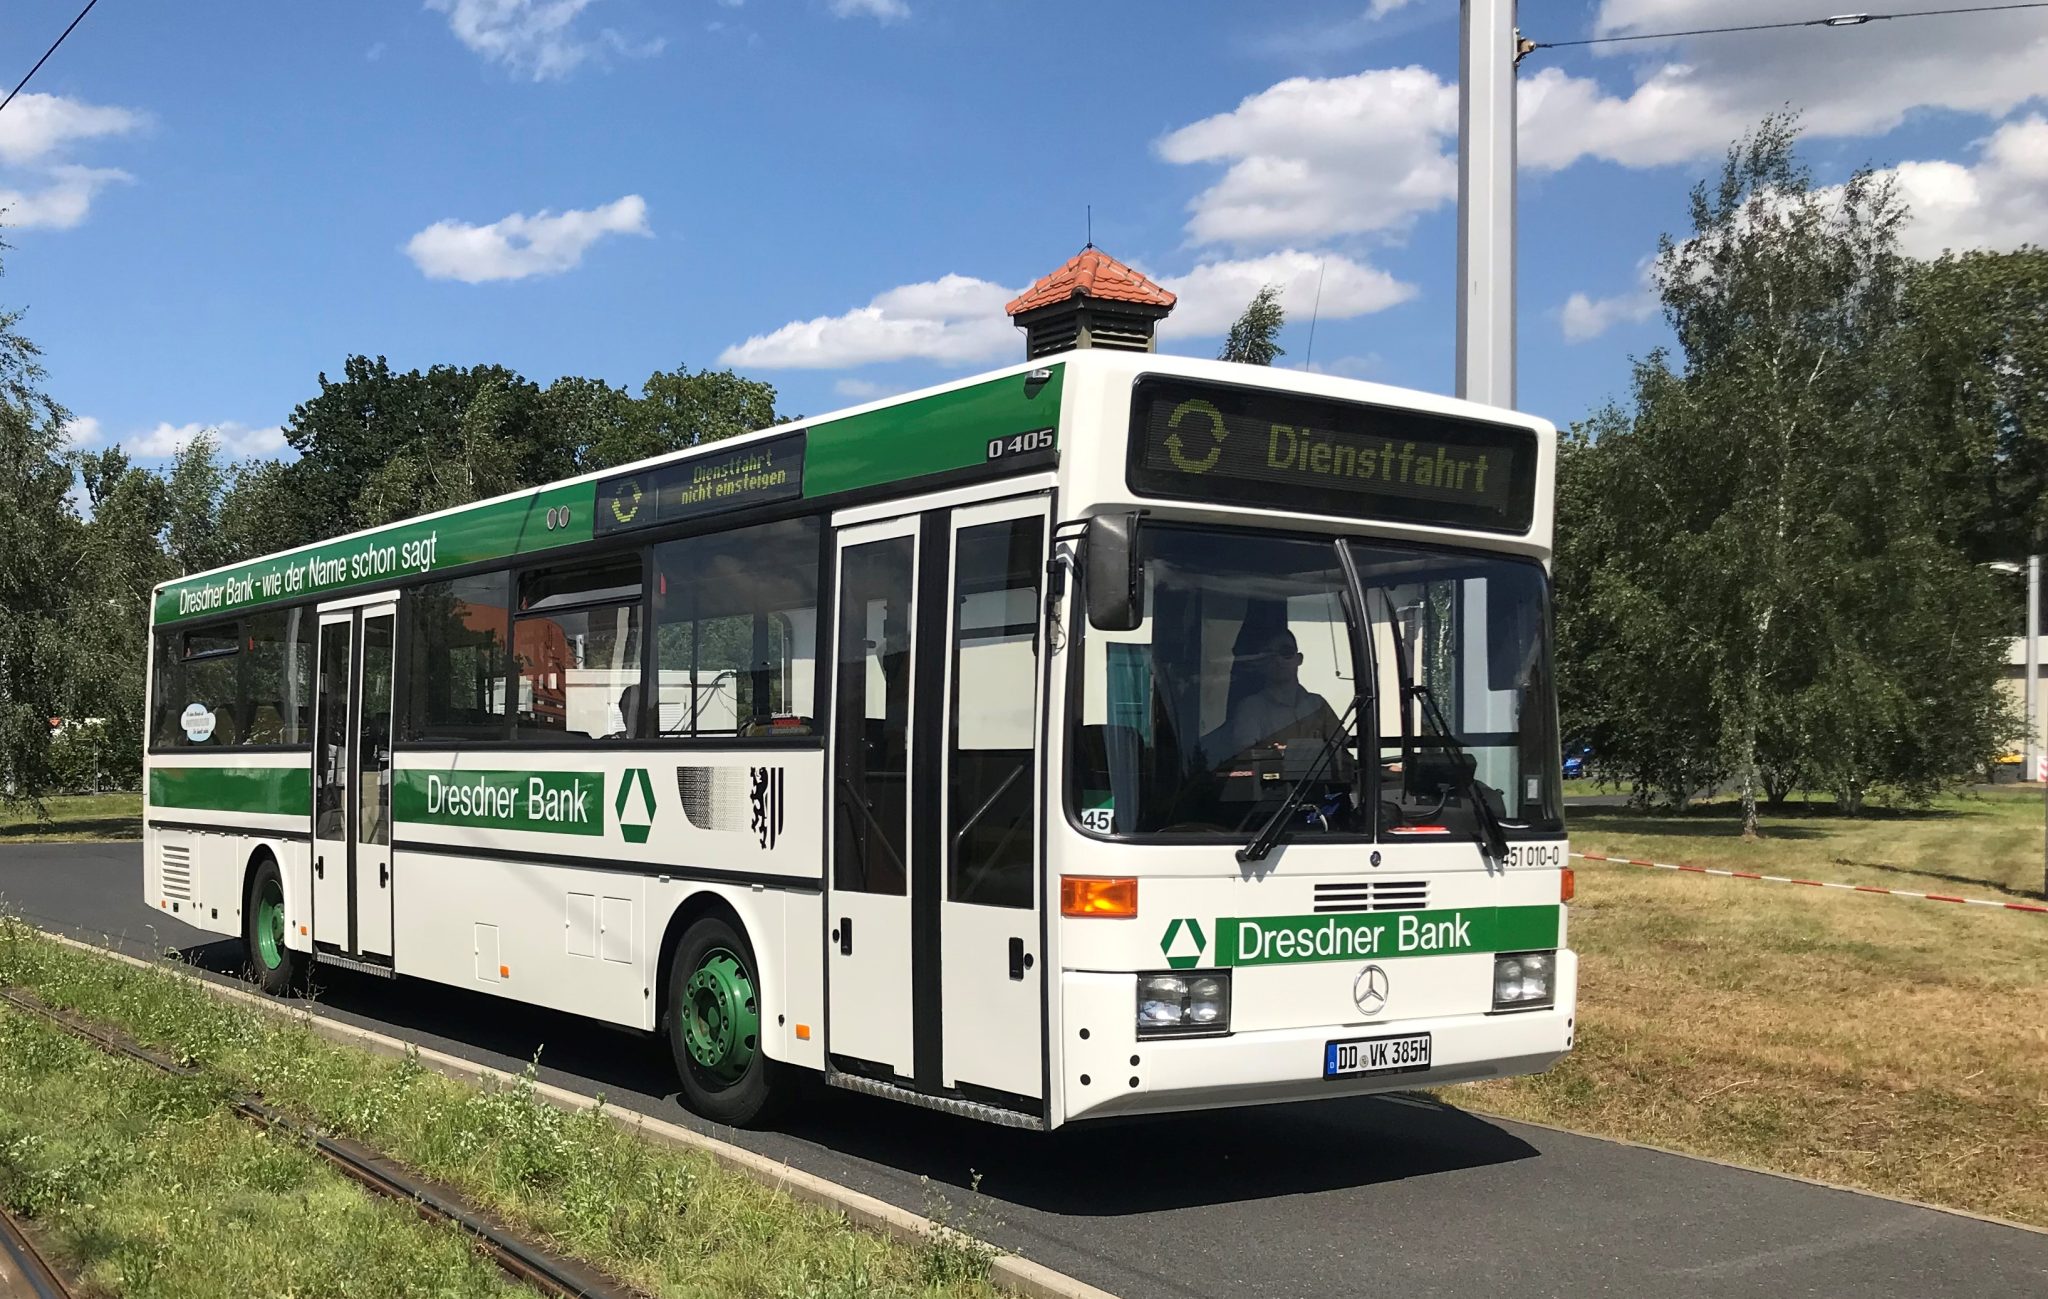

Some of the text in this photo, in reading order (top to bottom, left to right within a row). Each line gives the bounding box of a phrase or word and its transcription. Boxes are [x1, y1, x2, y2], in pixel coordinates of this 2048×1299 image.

[1007, 429, 1053, 452] 405
[1267, 424, 1488, 492] Dienstfahrt
[693, 448, 772, 484] Dienstfahrt
[681, 469, 786, 504] nicht einsteigen
[179, 582, 225, 615] Dresdner
[226, 572, 254, 605] Bank
[284, 561, 306, 593] der
[308, 555, 347, 588] Name
[351, 542, 396, 579] schon
[401, 530, 437, 573] sagt
[427, 774, 589, 823] Dresdner Bank
[1083, 811, 1110, 830] 45
[1526, 845, 1560, 867] 010-0
[1238, 912, 1472, 960] Dresdner Bank
[1338, 1038, 1428, 1070] DD VK 385H
